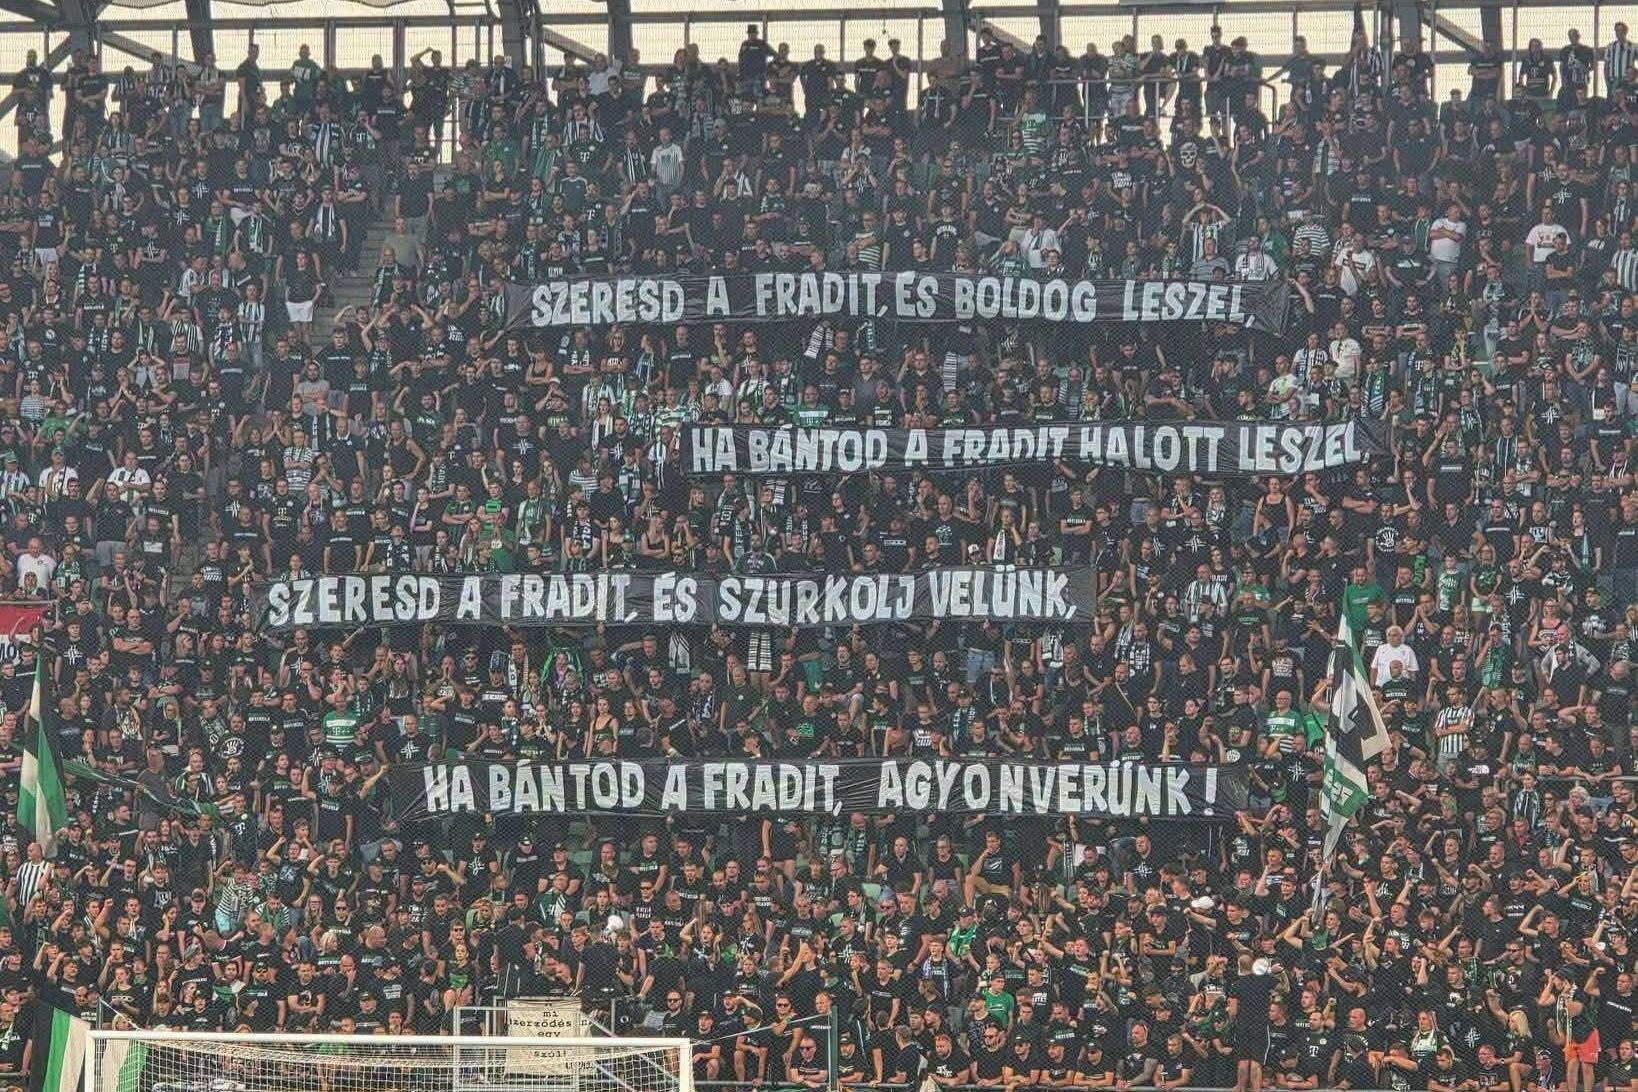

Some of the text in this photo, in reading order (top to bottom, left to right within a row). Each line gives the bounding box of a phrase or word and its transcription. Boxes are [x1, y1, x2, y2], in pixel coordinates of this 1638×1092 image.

[531, 279, 685, 327] SZERESD
[707, 276, 731, 317] A
[755, 272, 888, 317] FRADIT,
[954, 277, 1097, 323] BOLDOG
[1122, 279, 1255, 328] LESZEL,
[691, 427, 737, 472] HA
[748, 423, 887, 472] BÁNTOD
[905, 428, 929, 467] A
[942, 427, 1070, 467] FRADIT
[1080, 425, 1225, 472] HALOTT
[268, 564, 1077, 627] SZERESD A FRADIT, ÉS SZURKOLJ VELÜNK,
[423, 764, 475, 813] HA
[488, 759, 645, 813] BÁNTOD
[661, 764, 688, 811] A
[704, 763, 842, 817] FRADIT,
